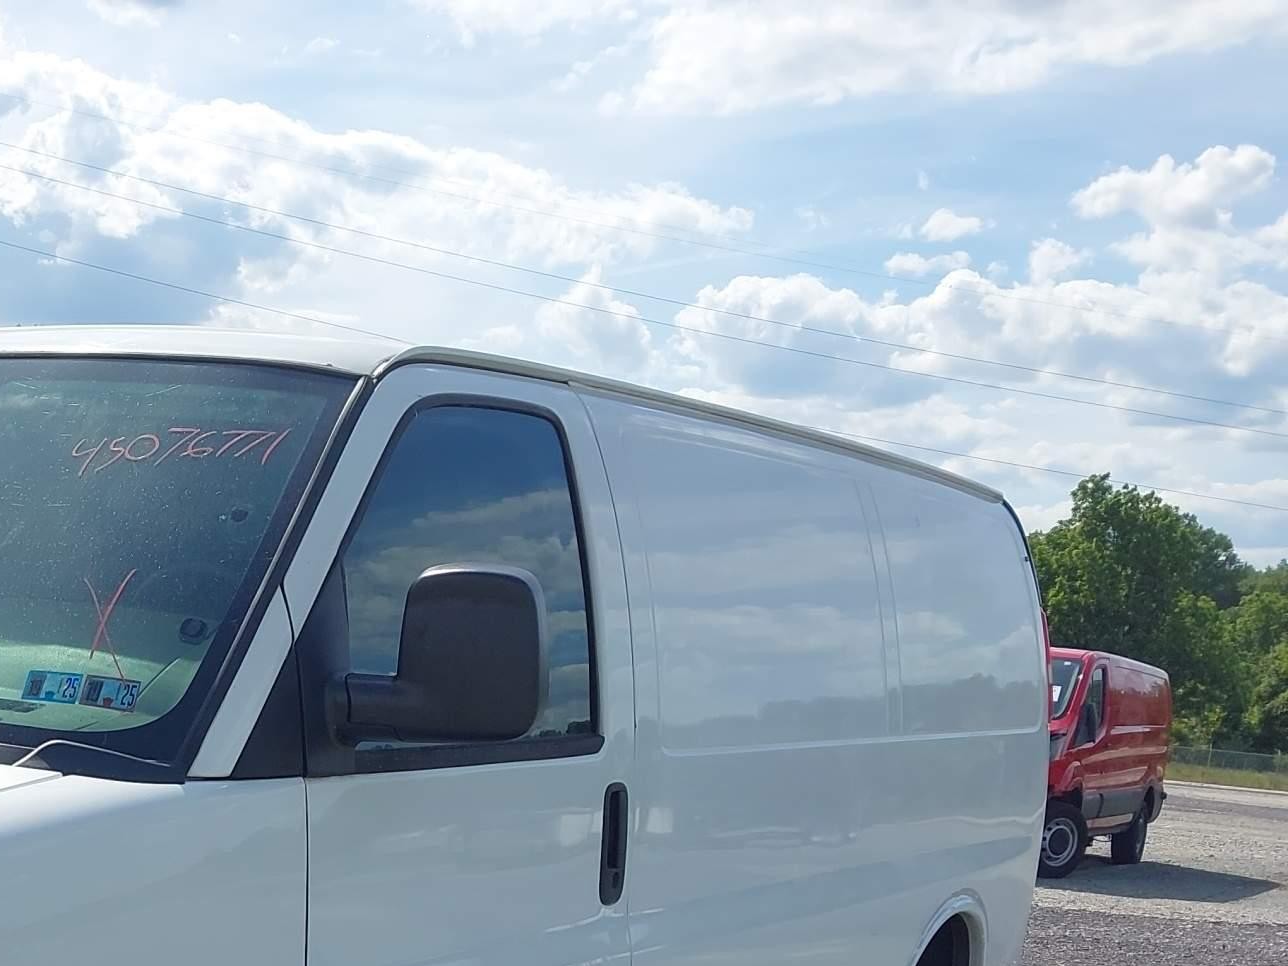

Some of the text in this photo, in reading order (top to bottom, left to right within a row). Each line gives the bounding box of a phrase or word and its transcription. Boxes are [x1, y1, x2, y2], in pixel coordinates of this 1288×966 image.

[71, 428, 292, 477] 45076771
[62, 678, 80, 698] 25
[120, 684, 137, 706] 25
